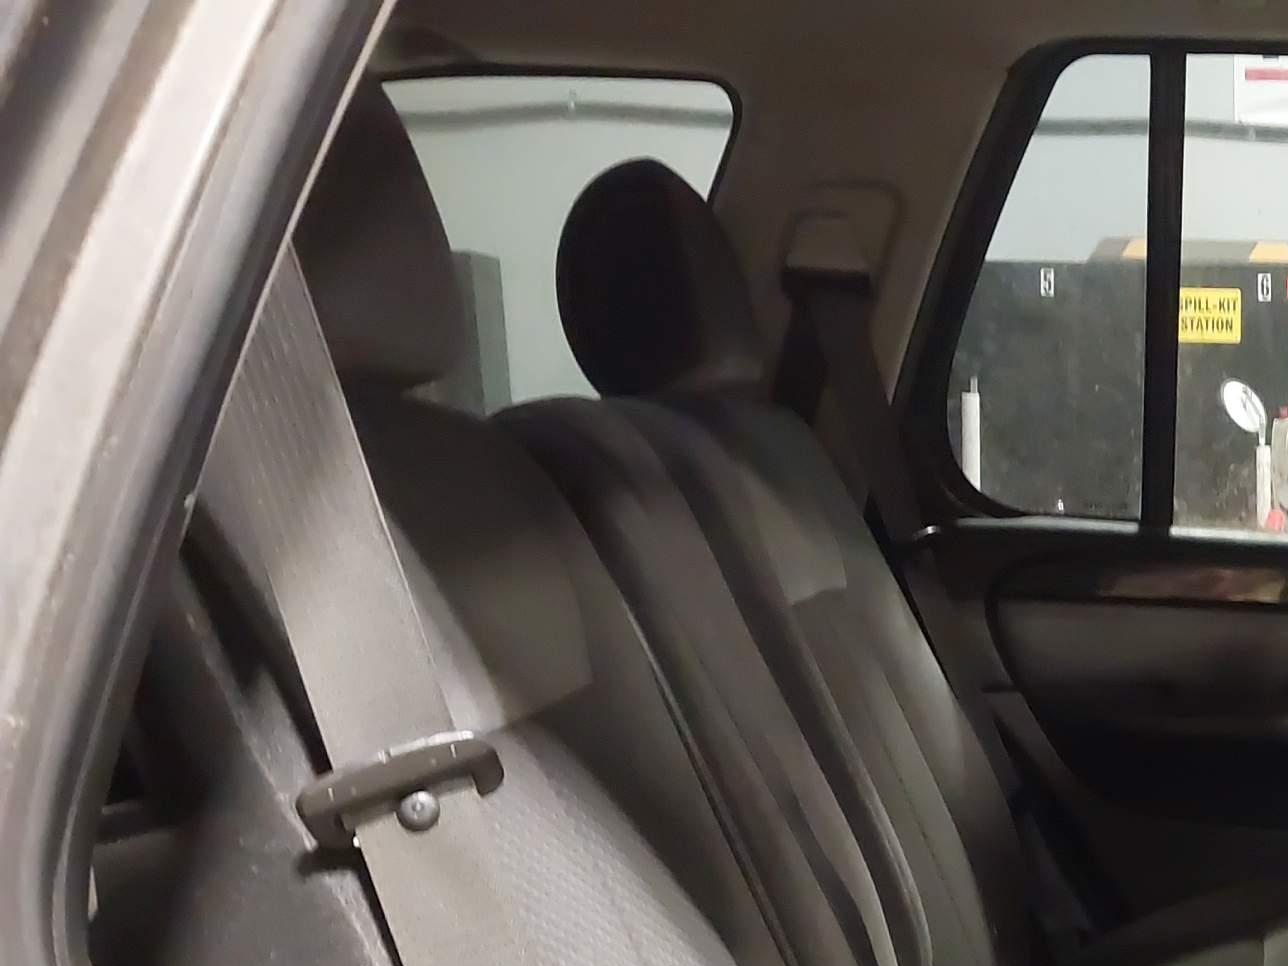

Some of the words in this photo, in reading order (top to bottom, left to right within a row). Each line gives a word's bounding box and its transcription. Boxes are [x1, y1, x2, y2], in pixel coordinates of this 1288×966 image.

[1042, 269, 1052, 297] 5
[1260, 274, 1270, 300] 6
[1181, 317, 1233, 332] STATION
